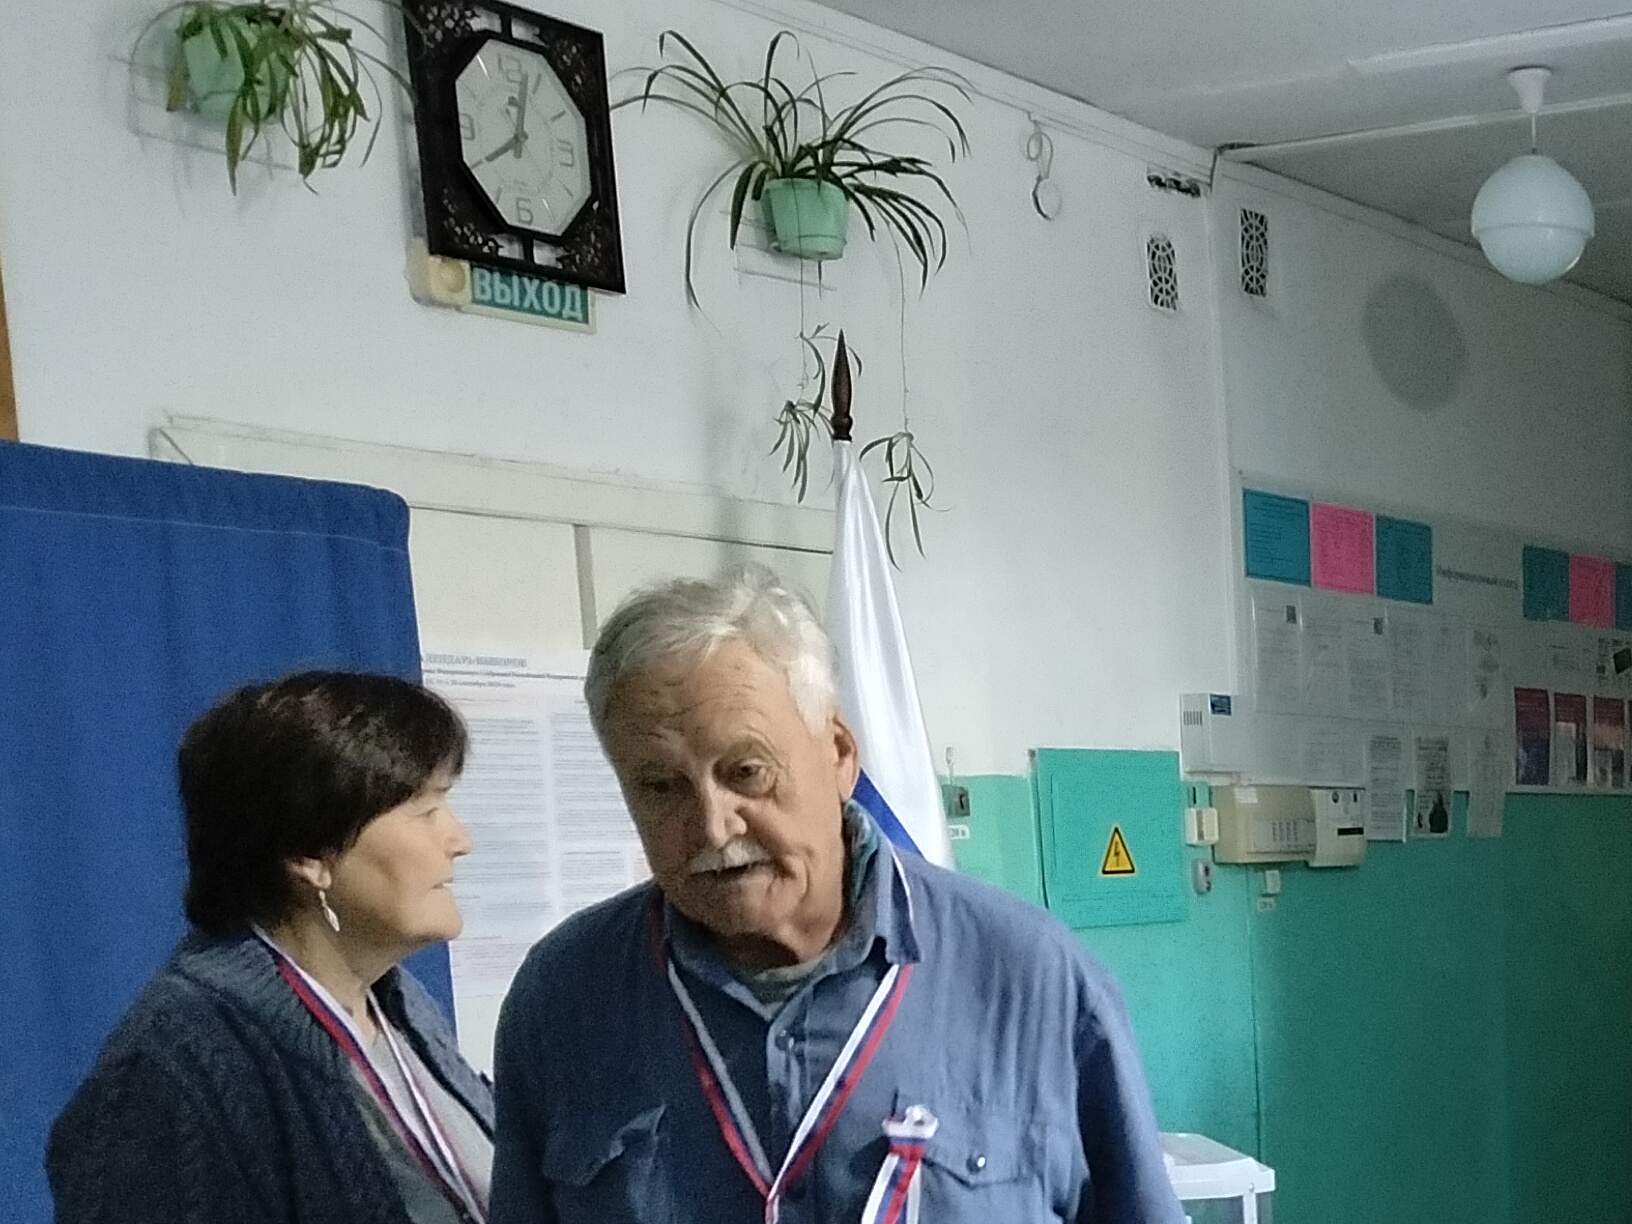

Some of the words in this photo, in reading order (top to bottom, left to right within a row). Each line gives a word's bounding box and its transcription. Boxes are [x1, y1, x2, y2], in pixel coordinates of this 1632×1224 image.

[557, 138, 575, 168] 3
[516, 196, 534, 226] 6
[473, 267, 583, 321] ВЫХОД
